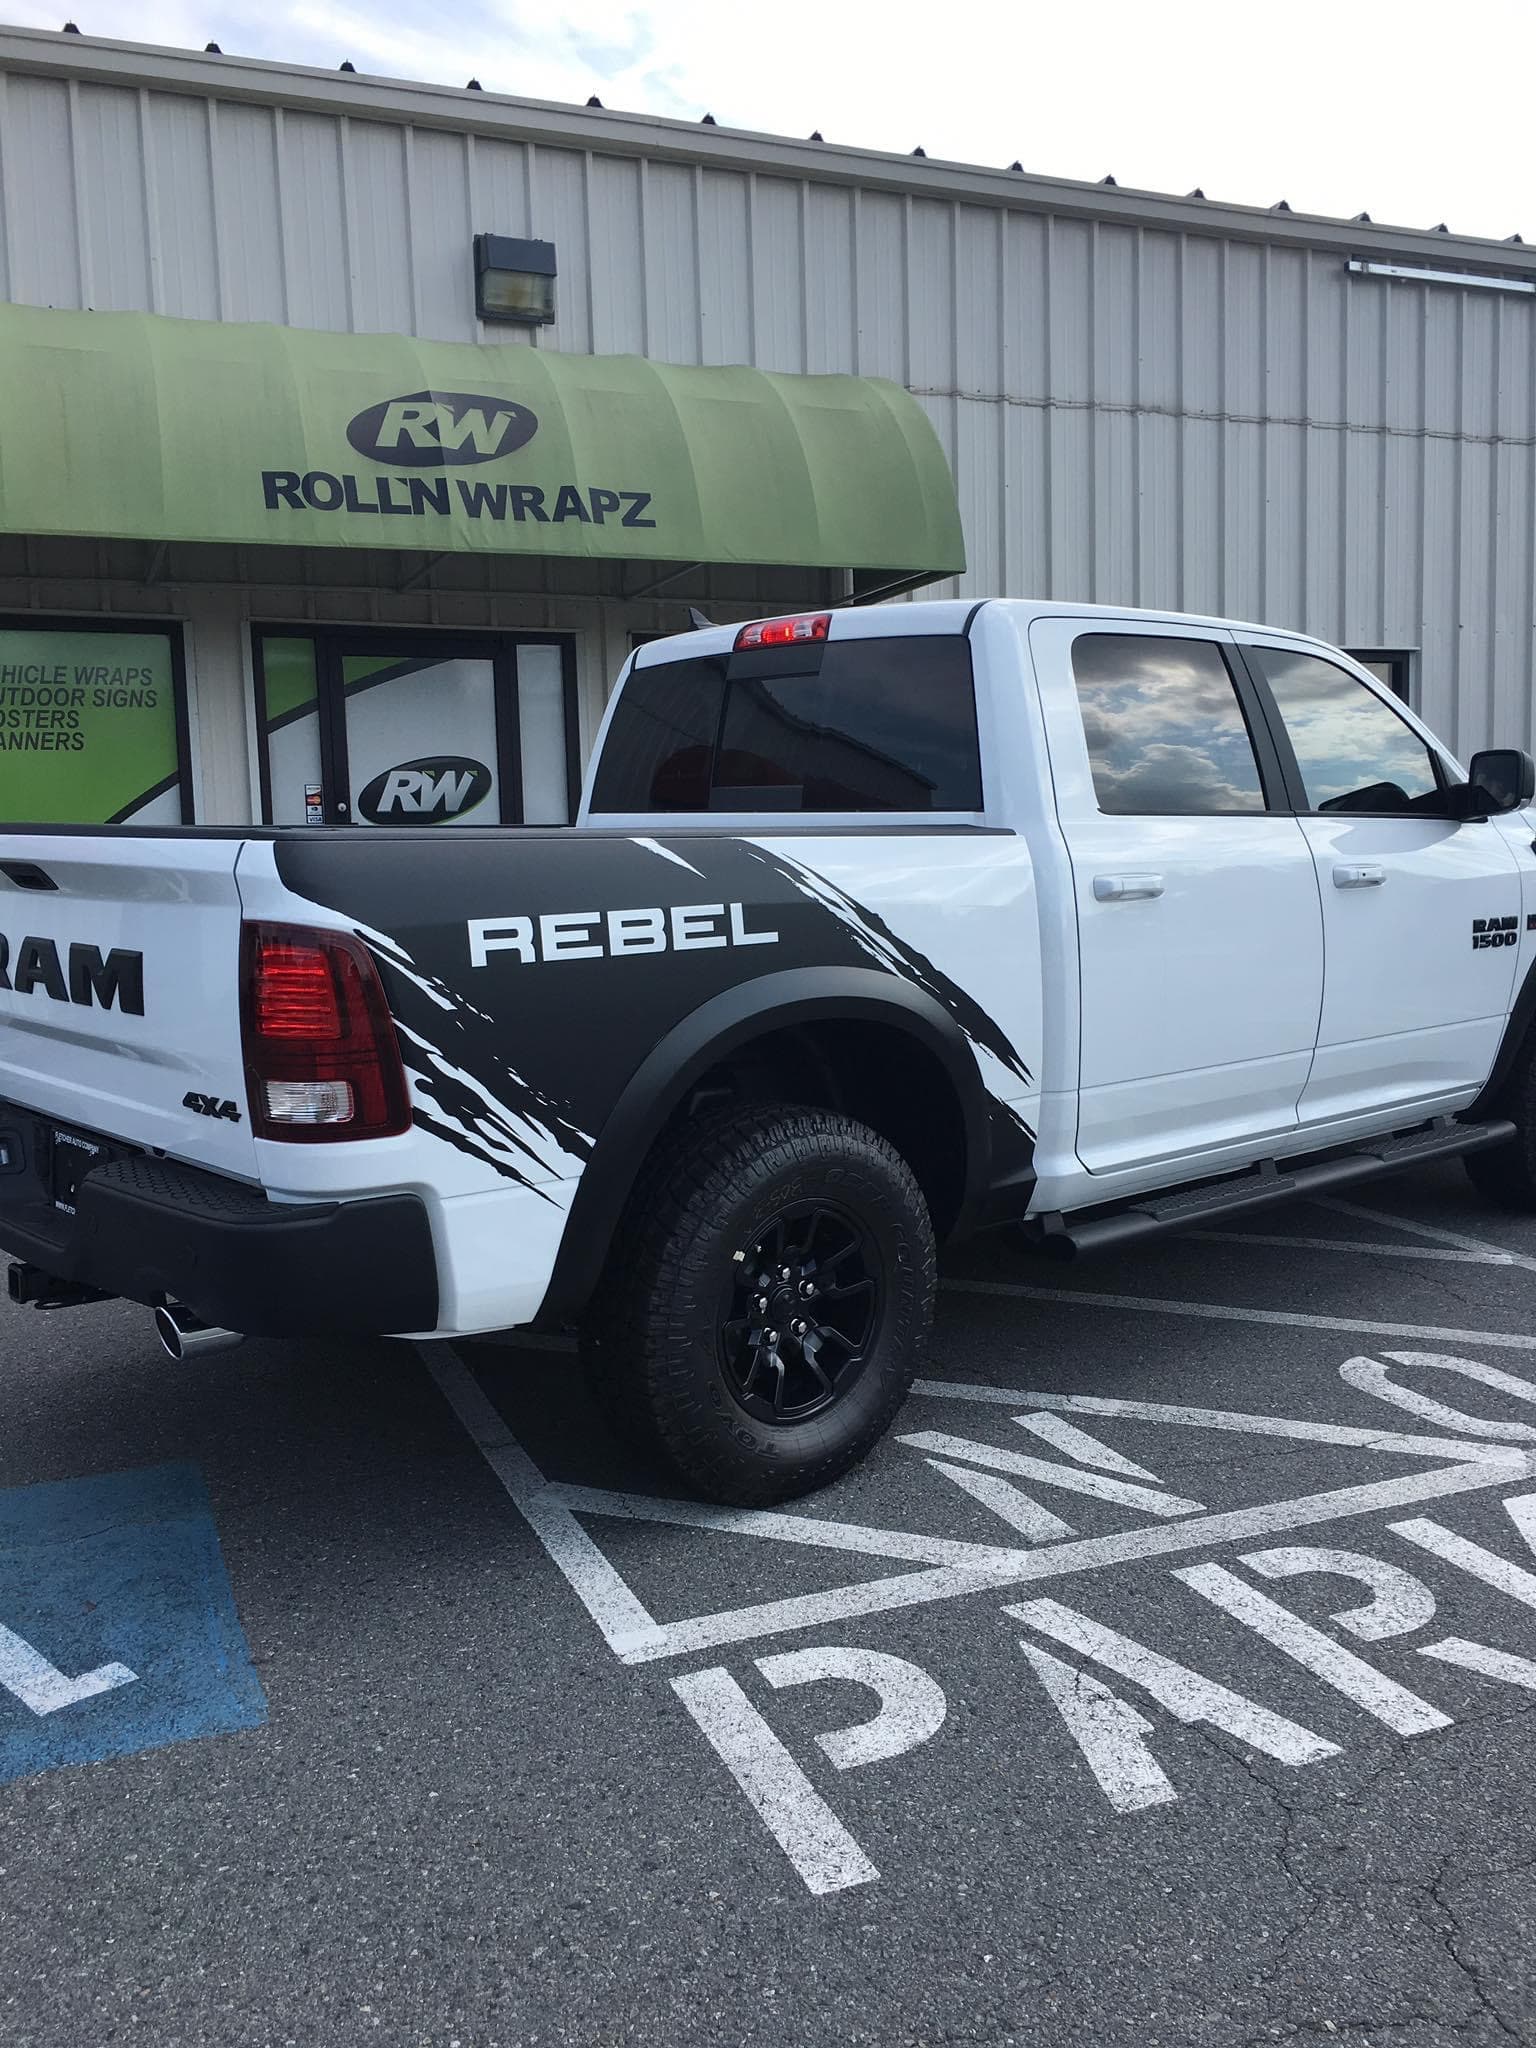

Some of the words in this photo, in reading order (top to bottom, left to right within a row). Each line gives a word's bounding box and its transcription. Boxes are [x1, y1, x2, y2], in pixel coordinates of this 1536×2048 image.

[375, 401, 516, 454] RW
[261, 470, 451, 516] ROLL'N
[456, 479, 656, 528] WRAPZ
[74, 666, 152, 686] WRAPS
[92, 689, 157, 708] SIGNS
[376, 770, 479, 812] RW
[467, 902, 779, 967] REBEL
[1472, 916, 1518, 934] RAM
[1472, 931, 1518, 950] 1500
